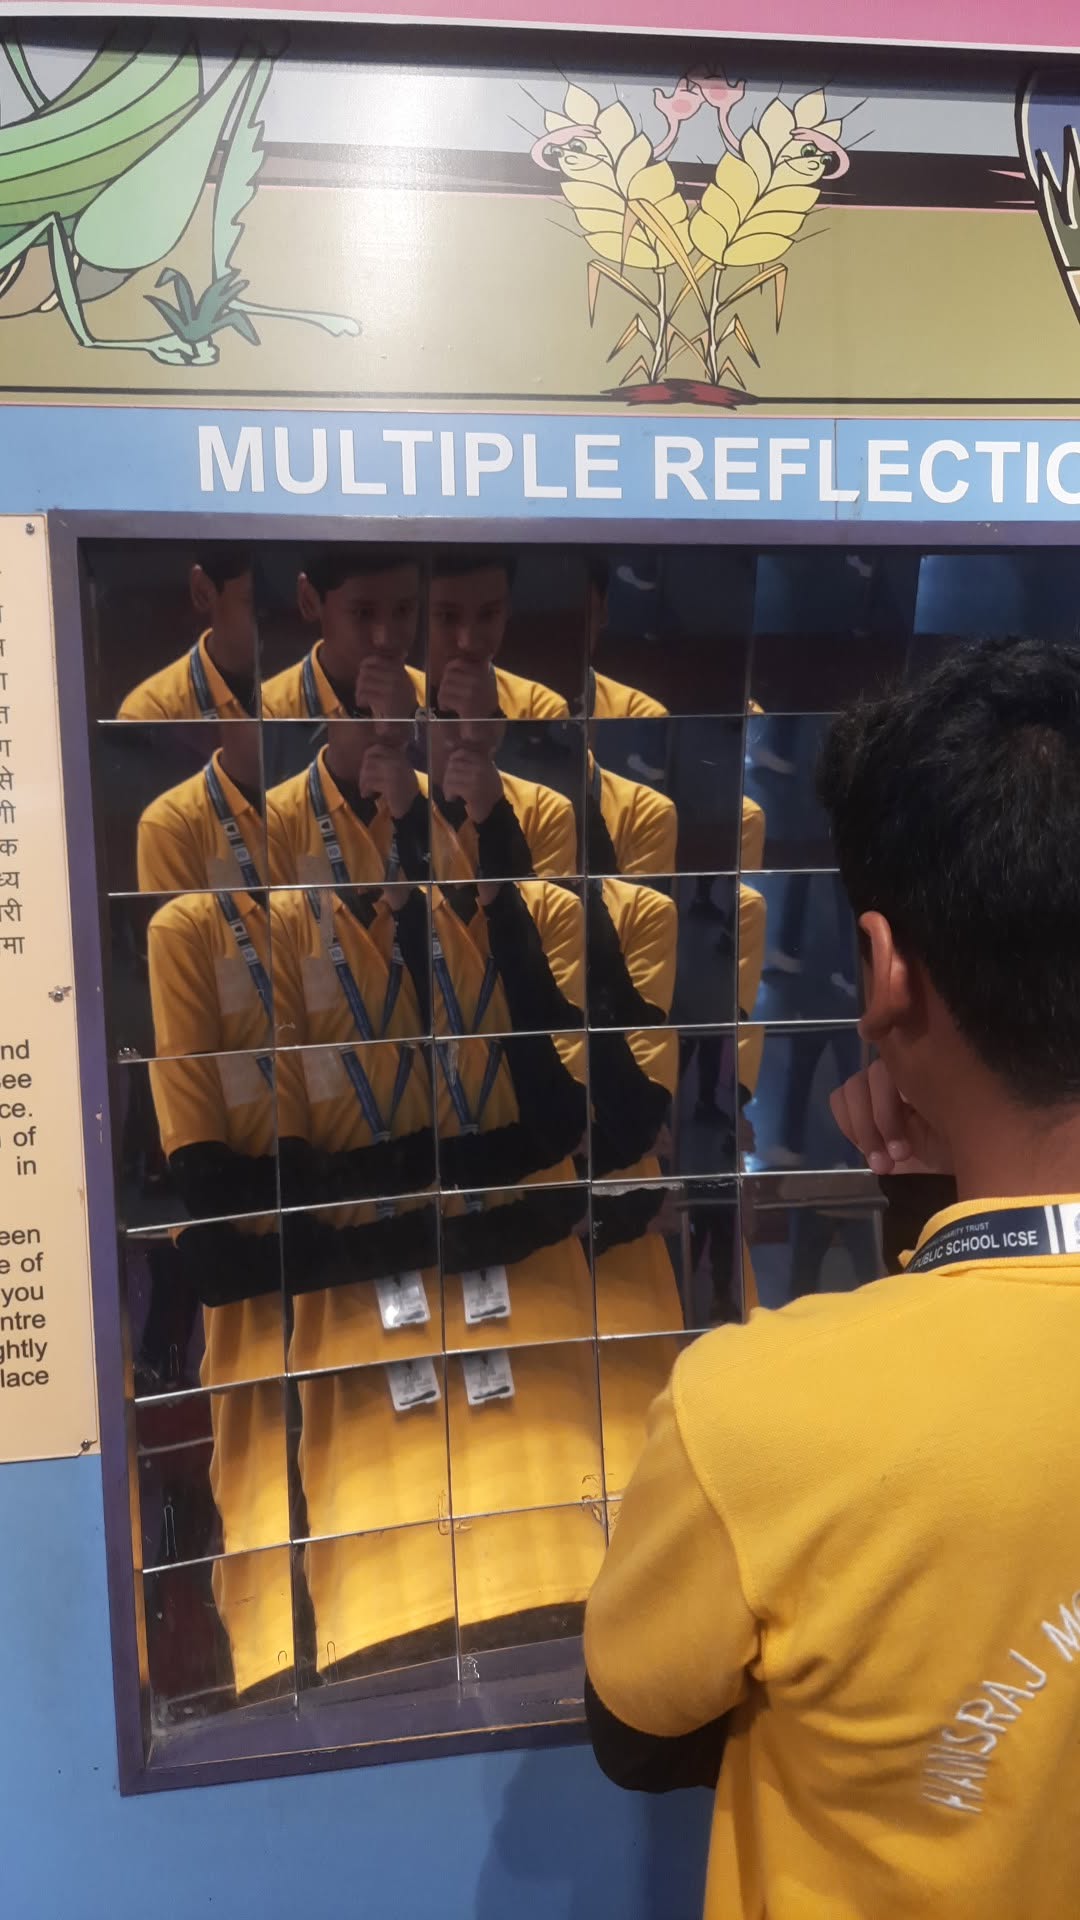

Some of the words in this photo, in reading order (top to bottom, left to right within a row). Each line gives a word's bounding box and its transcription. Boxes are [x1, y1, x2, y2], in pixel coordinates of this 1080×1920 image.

[198, 425, 622, 499] MULTIPLE
[654, 435, 1080, 505] REFLECTIO
[0, 1073, 32, 1090] ee
[13, 1126, 37, 1147] of
[16, 1156, 37, 1176] in
[966, 1221, 990, 1232] TRUST
[914, 1245, 944, 1268] PUBLIC
[945, 1235, 999, 1254] SCHOOL
[1003, 1230, 1039, 1248] ICSE
[20, 1252, 44, 1274] of
[1, 1285, 44, 1308] you
[0, 1369, 49, 1388] lace
[921, 1648, 1047, 1813] HANSRAJ
